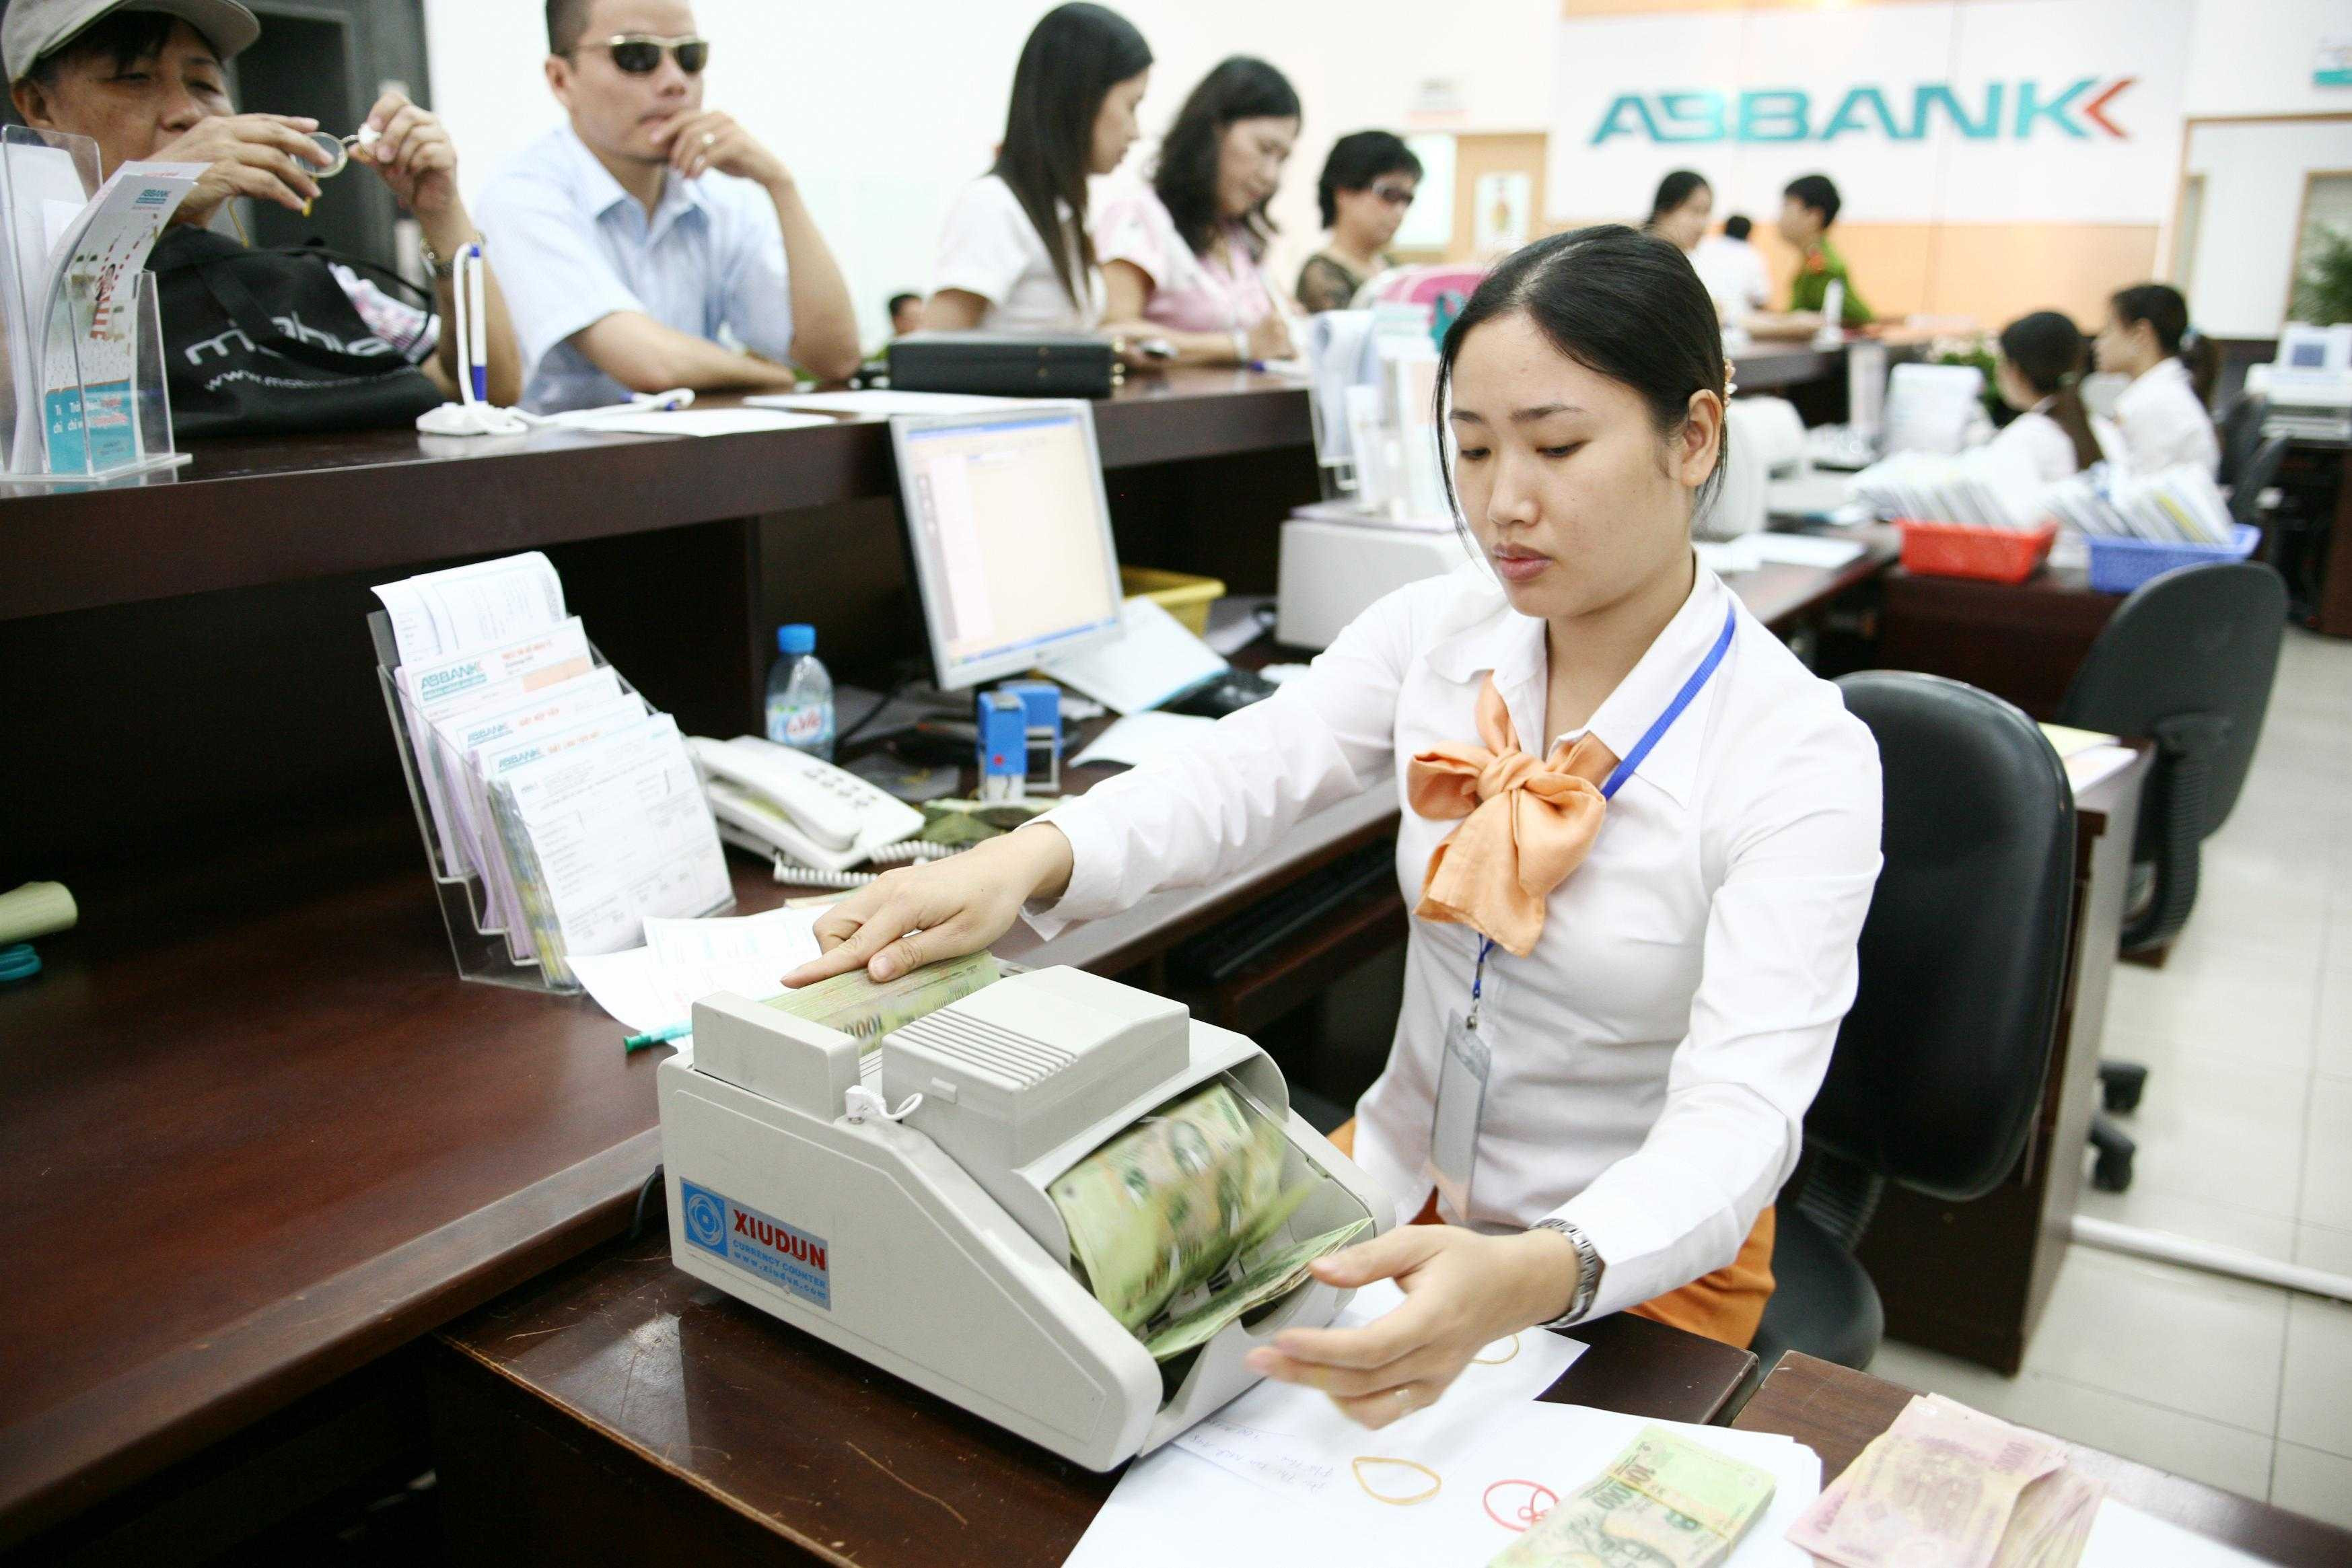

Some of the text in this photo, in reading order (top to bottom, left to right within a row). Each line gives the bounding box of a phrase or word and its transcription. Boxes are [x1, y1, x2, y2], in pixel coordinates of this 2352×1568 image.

[1588, 75, 2105, 146] ABBANK
[421, 660, 481, 690] ABBANK
[733, 1209, 826, 1271] XIUDUN
